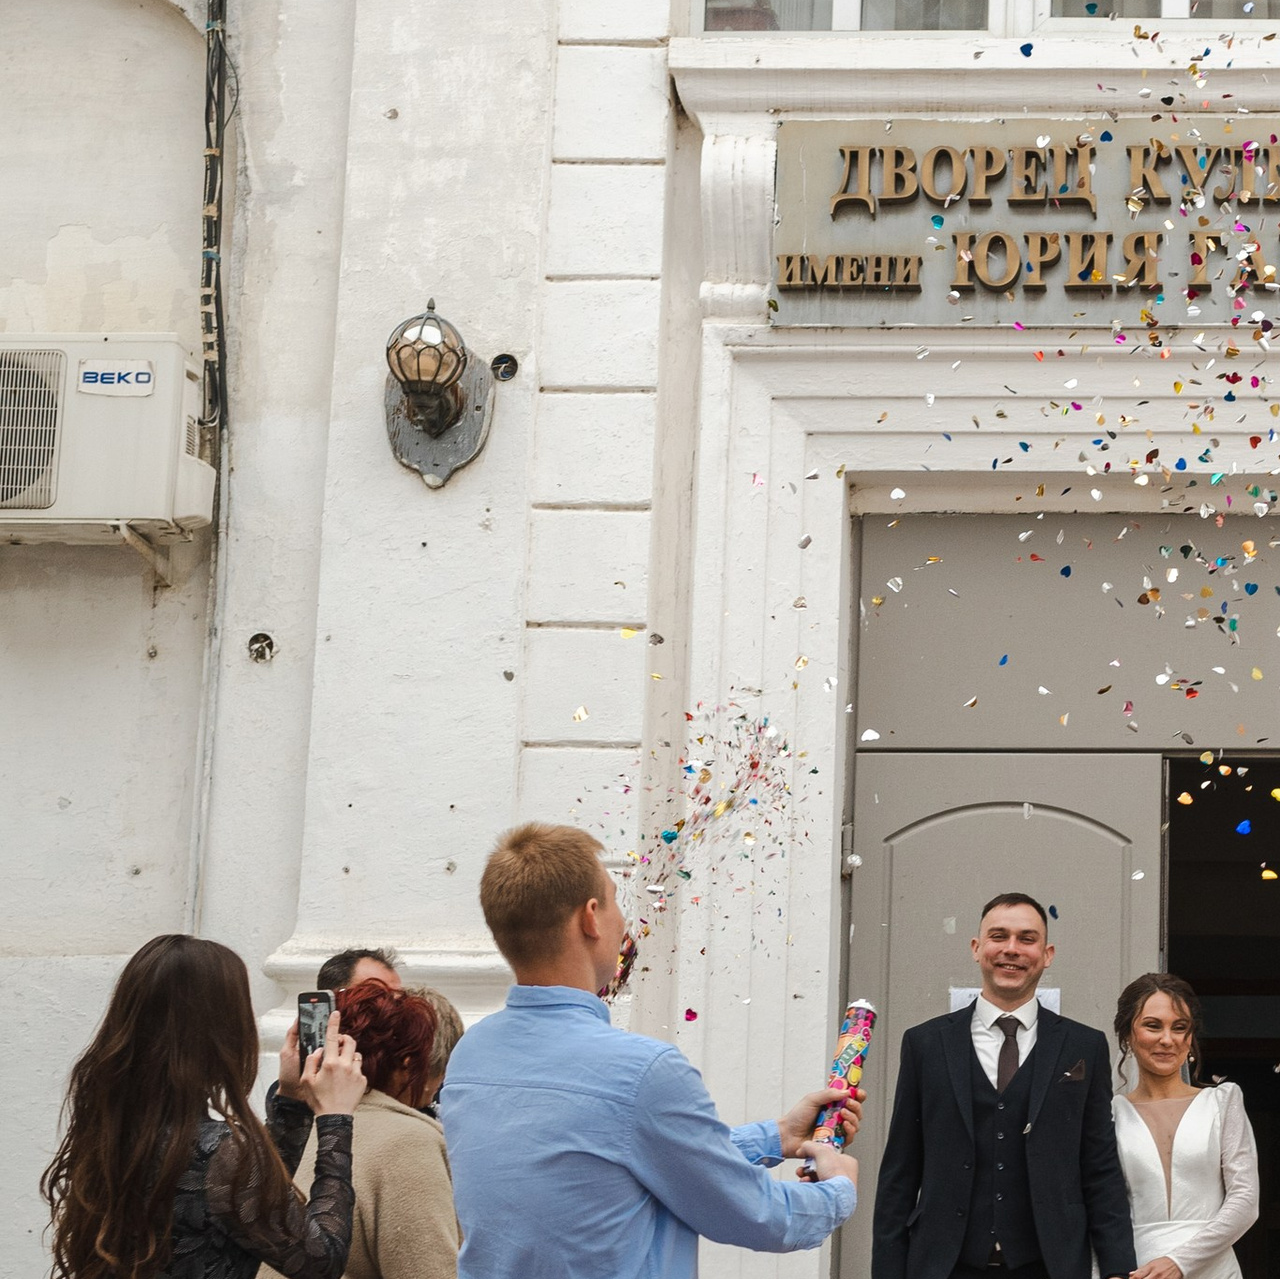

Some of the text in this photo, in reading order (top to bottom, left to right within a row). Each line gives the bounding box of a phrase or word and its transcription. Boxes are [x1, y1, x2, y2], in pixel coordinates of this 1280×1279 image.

[829, 144, 1098, 222] ДВОРЕЦ
[949, 230, 1164, 293] ЮРИЯ
[82, 371, 152, 384] BEKO
